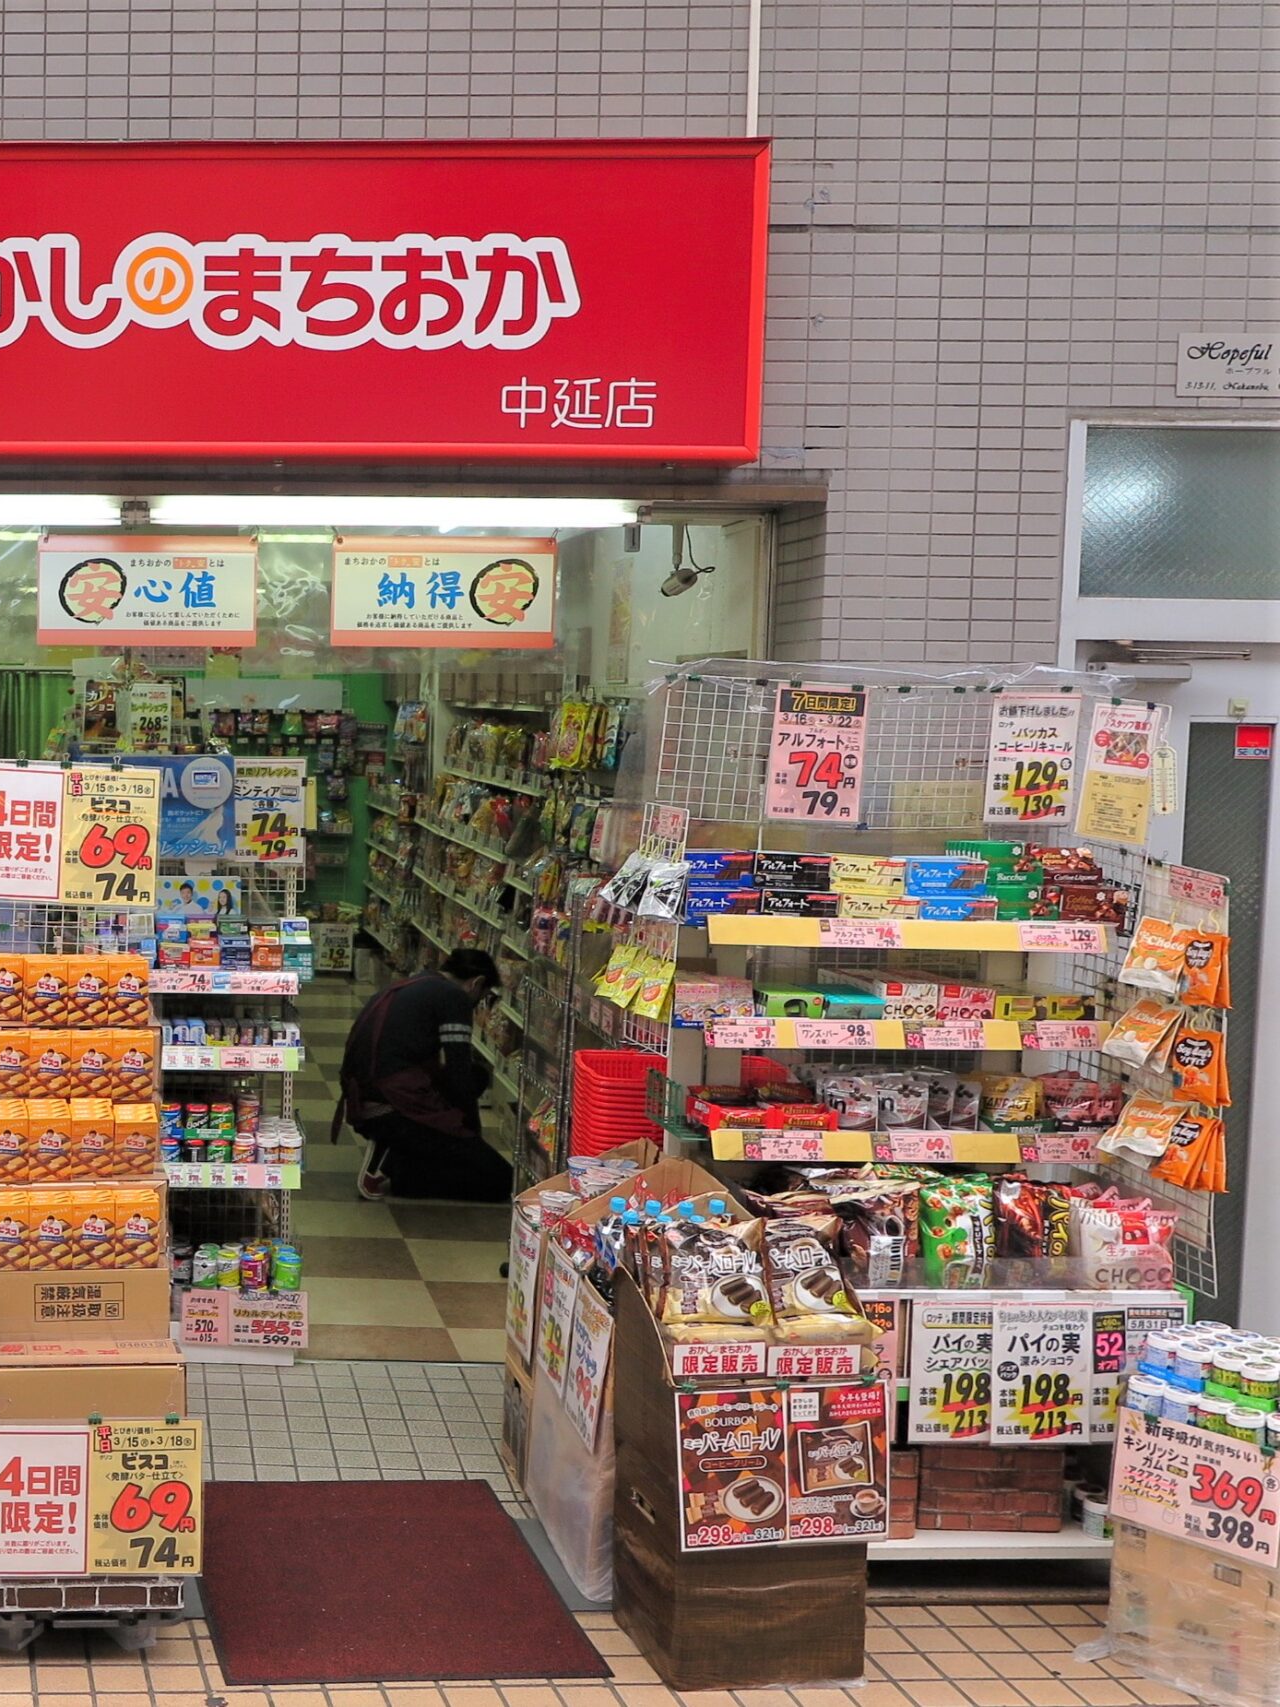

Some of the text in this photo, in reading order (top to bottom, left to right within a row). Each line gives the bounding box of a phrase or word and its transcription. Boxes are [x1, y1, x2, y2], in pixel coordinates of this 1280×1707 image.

[1187, 341, 1273, 366] Hopeful
[499, 378, 657, 431] 中延店
[134, 571, 216, 608] 心値
[377, 571, 464, 609] 納得
[792, 693, 856, 711] 7日間限定!
[777, 732, 844, 750] アルフォート
[234, 785, 280, 798] ミンティア
[91, 797, 131, 814] ビスコ
[761, 860, 802, 871] アルフォート
[835, 862, 876, 874] アルフォート
[997, 873, 1027, 882] Bacchus
[688, 898, 730, 908] アルフォート
[39, 981, 57, 992] ビスコ
[40, 1303, 102, 1319] 取扱注意
[1007, 1333, 1080, 1353] パイの実
[1095, 1333, 1123, 1356] 52
[682, 1354, 759, 1373] 限定販売
[777, 1356, 853, 1374] 限定販売
[1020, 1356, 1073, 1367] 深みショコラ
[704, 1415, 757, 1428] BOURBON
[683, 1428, 781, 1455] ミニバームロール
[1123, 1436, 1189, 1467] キシリッシュ
[121, 1453, 169, 1471] ビスコ
[1142, 1455, 1164, 1472] ガム
[0, 1501, 76, 1535] 限定!
